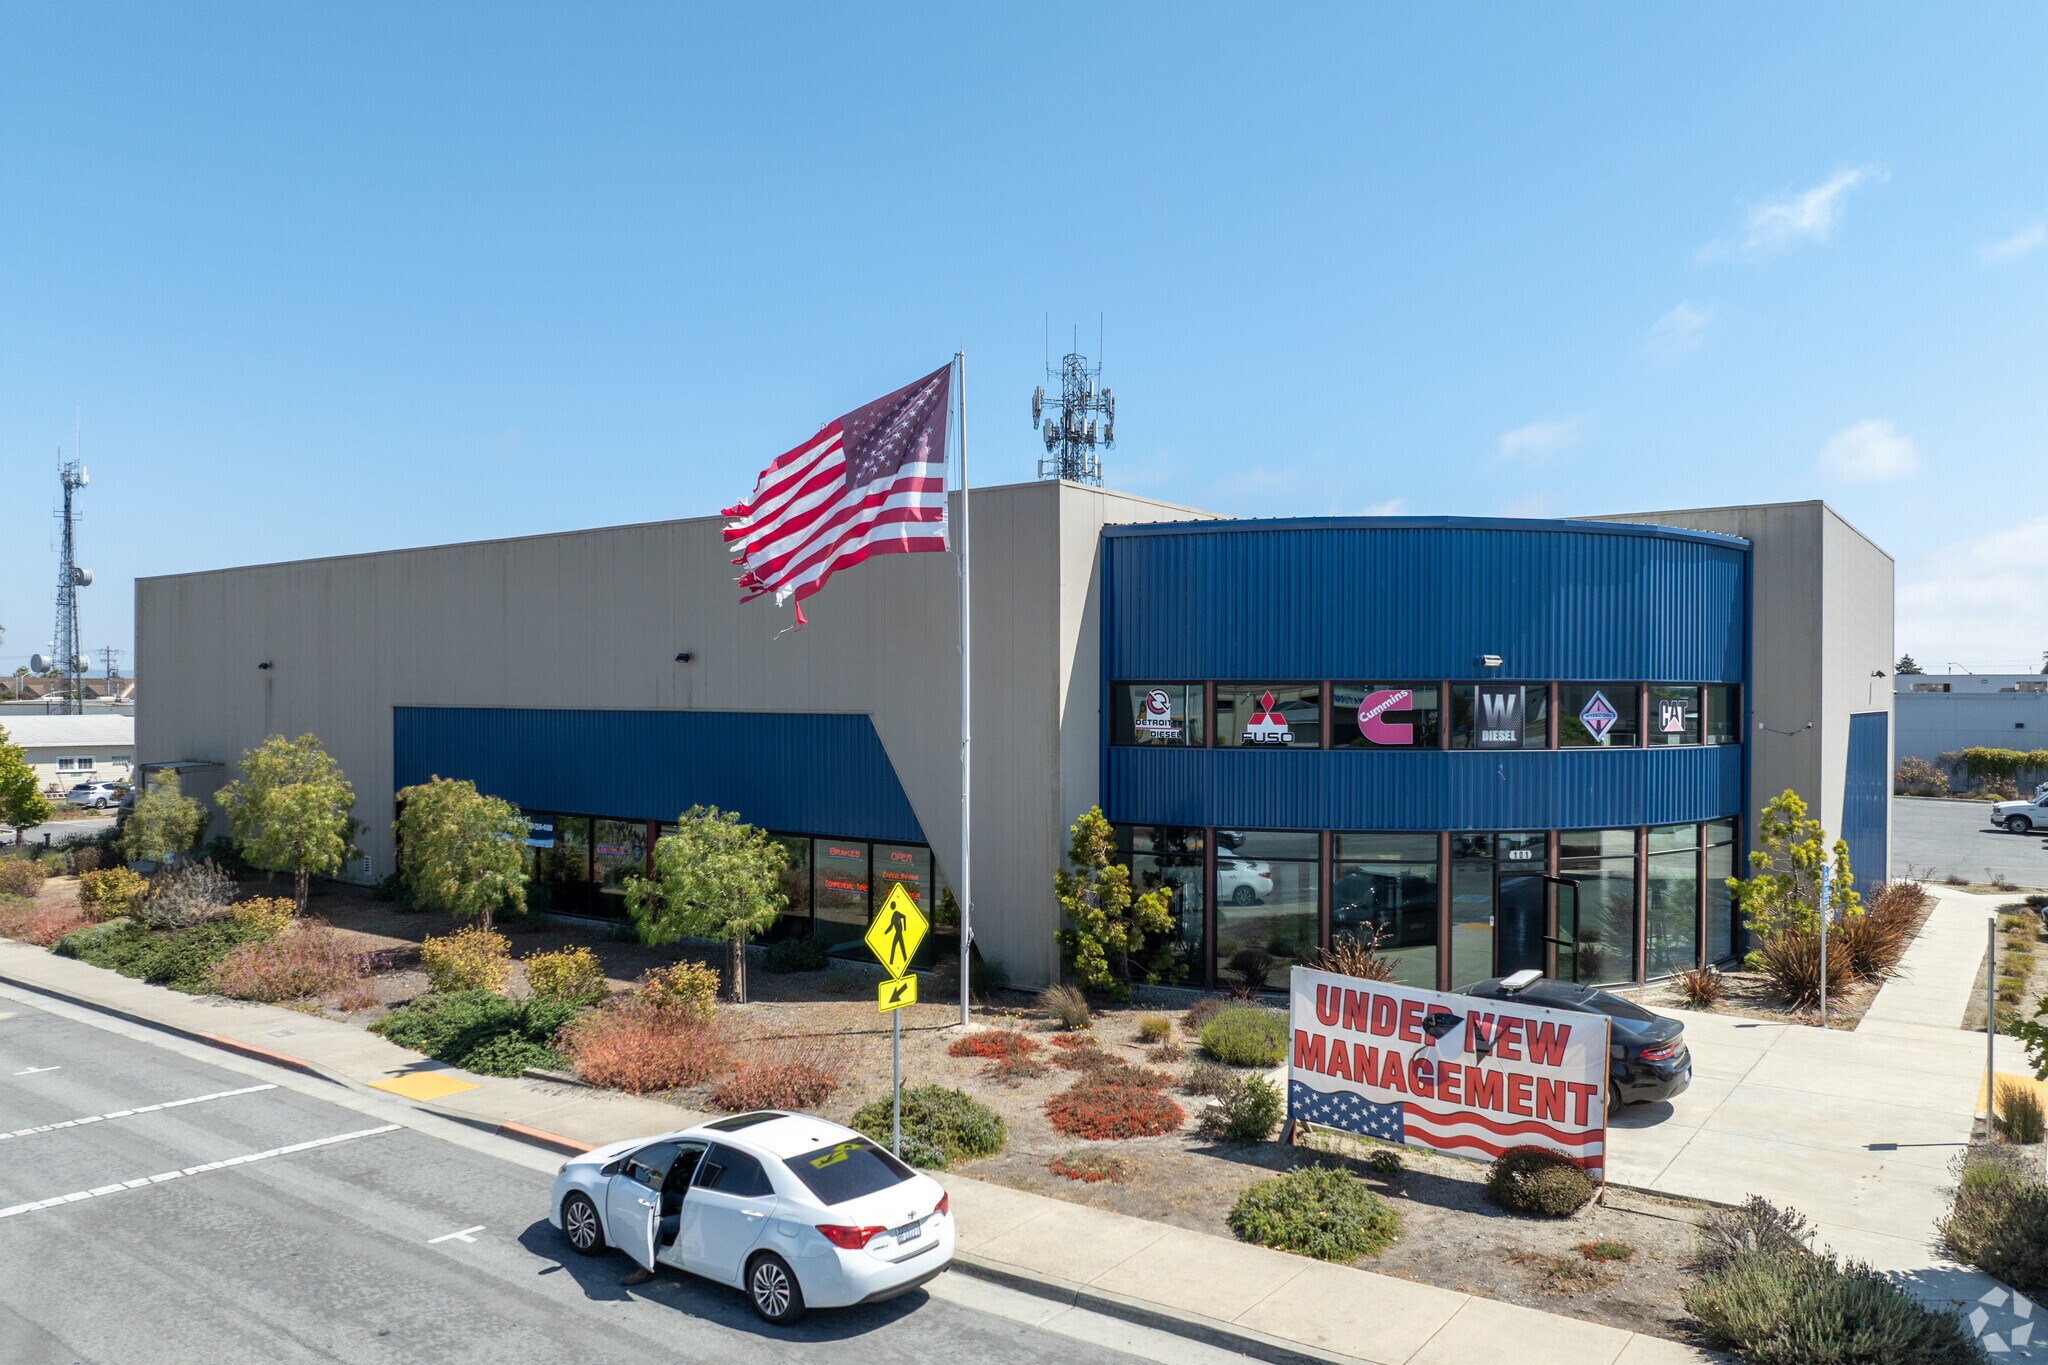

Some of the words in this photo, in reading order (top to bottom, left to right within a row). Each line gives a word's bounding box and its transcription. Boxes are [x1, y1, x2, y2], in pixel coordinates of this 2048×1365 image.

[1359, 690, 1408, 722] Cummins
[1482, 694, 1516, 728] W
[1659, 700, 1688, 732] CAT
[1135, 719, 1172, 727] DETROIT
[1150, 731, 1181, 739] DIESEL
[1241, 732, 1295, 744] FUSO
[1482, 730, 1517, 741] DIESEL
[829, 847, 860, 857] BRAKES
[890, 852, 913, 863] OPEN
[1294, 1029, 1598, 1126] MANAGEMENT
